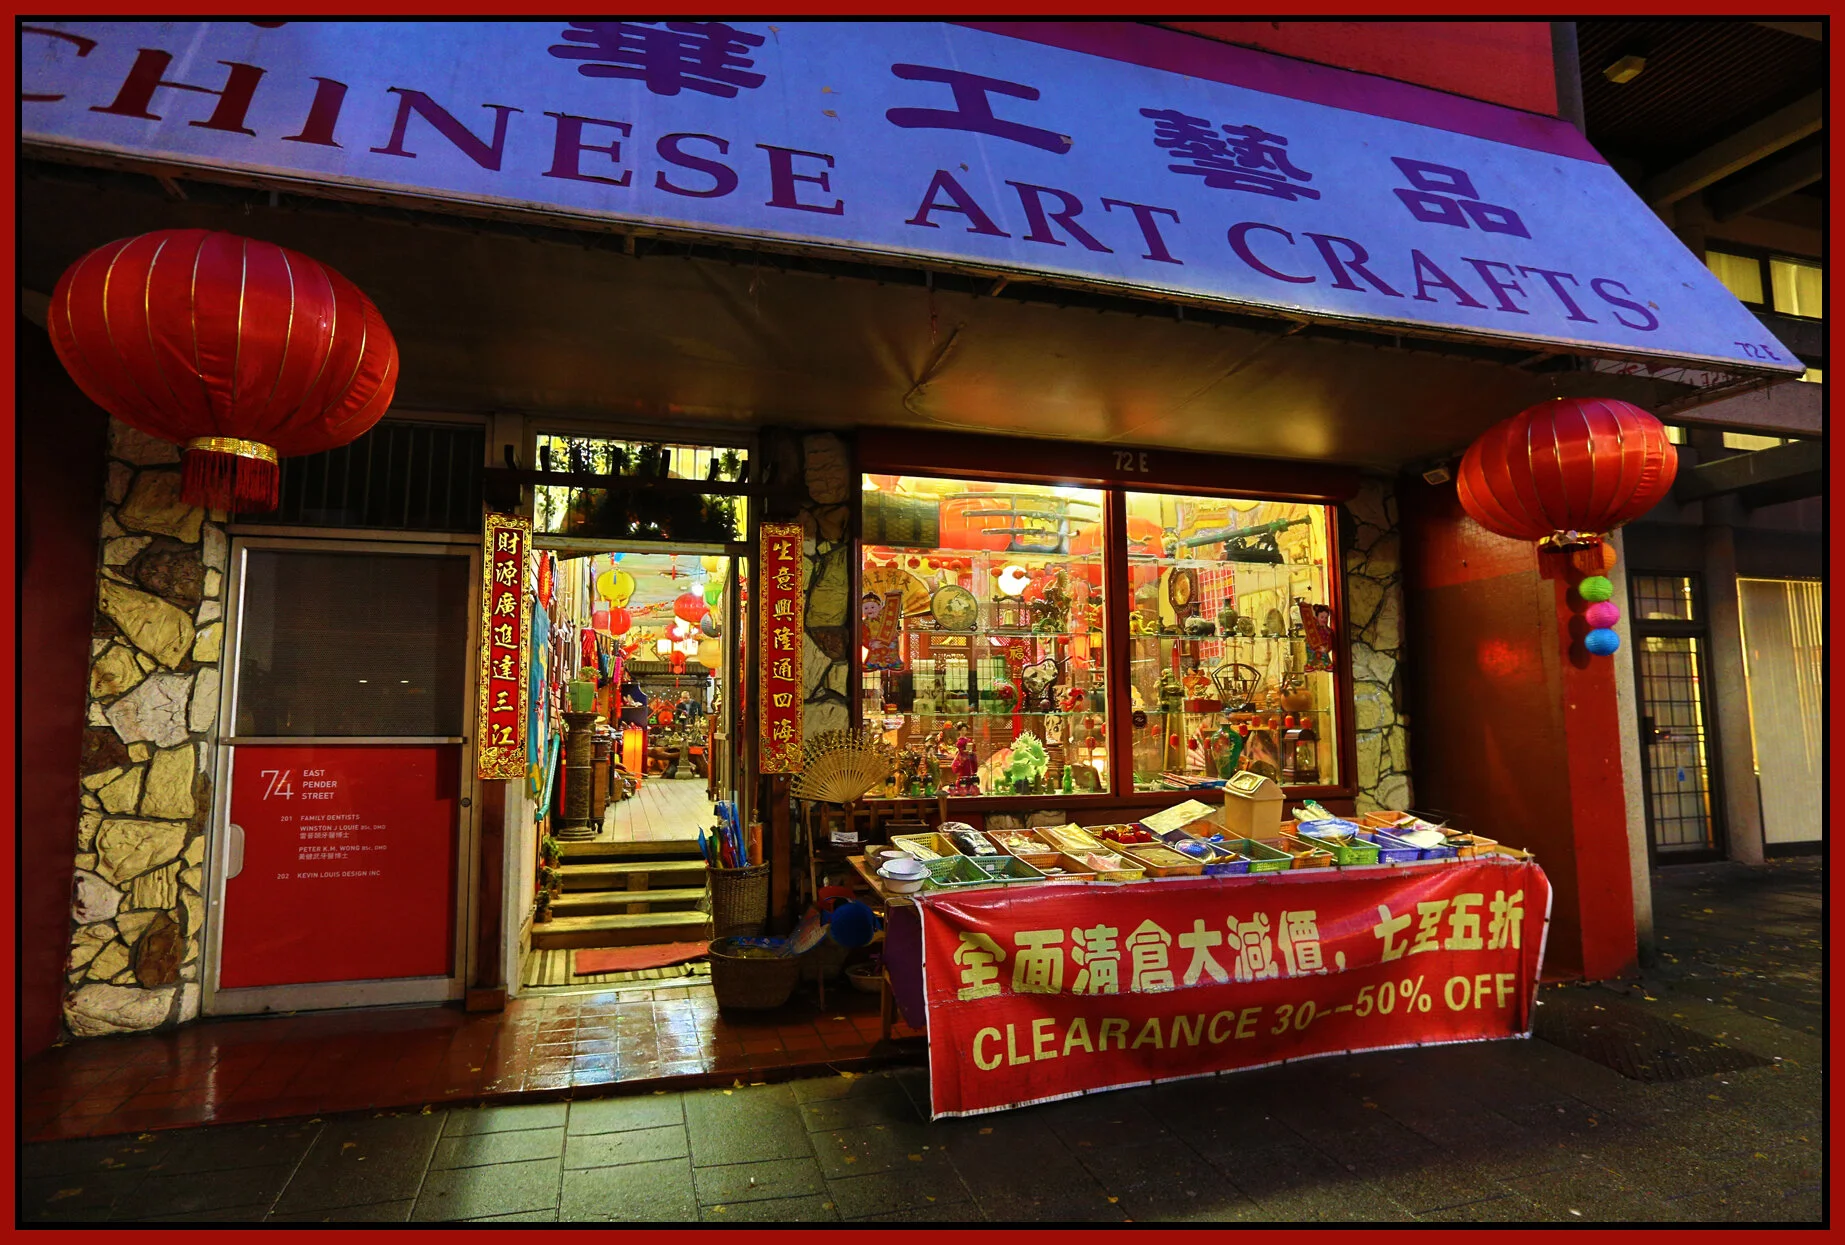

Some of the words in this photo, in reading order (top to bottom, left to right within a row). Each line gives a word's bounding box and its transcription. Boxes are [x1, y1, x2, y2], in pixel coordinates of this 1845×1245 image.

[906, 169, 1184, 265] ART
[1227, 220, 1660, 332] CRAFTS
[1734, 342, 1767, 358] 72
[1765, 345, 1781, 361] E
[1112, 451, 1134, 471] 72
[1139, 452, 1149, 472] E
[491, 532, 521, 746] 財源廣進達三江
[771, 540, 796, 743] 生意興隆通四海
[261, 770, 294, 800] 74
[303, 769, 325, 777] EAST
[303, 780, 337, 789] PENDER
[302, 792, 334, 800] STREET
[972, 1006, 1262, 1071] CLEARANCE
[1444, 973, 1516, 1012] OFF
